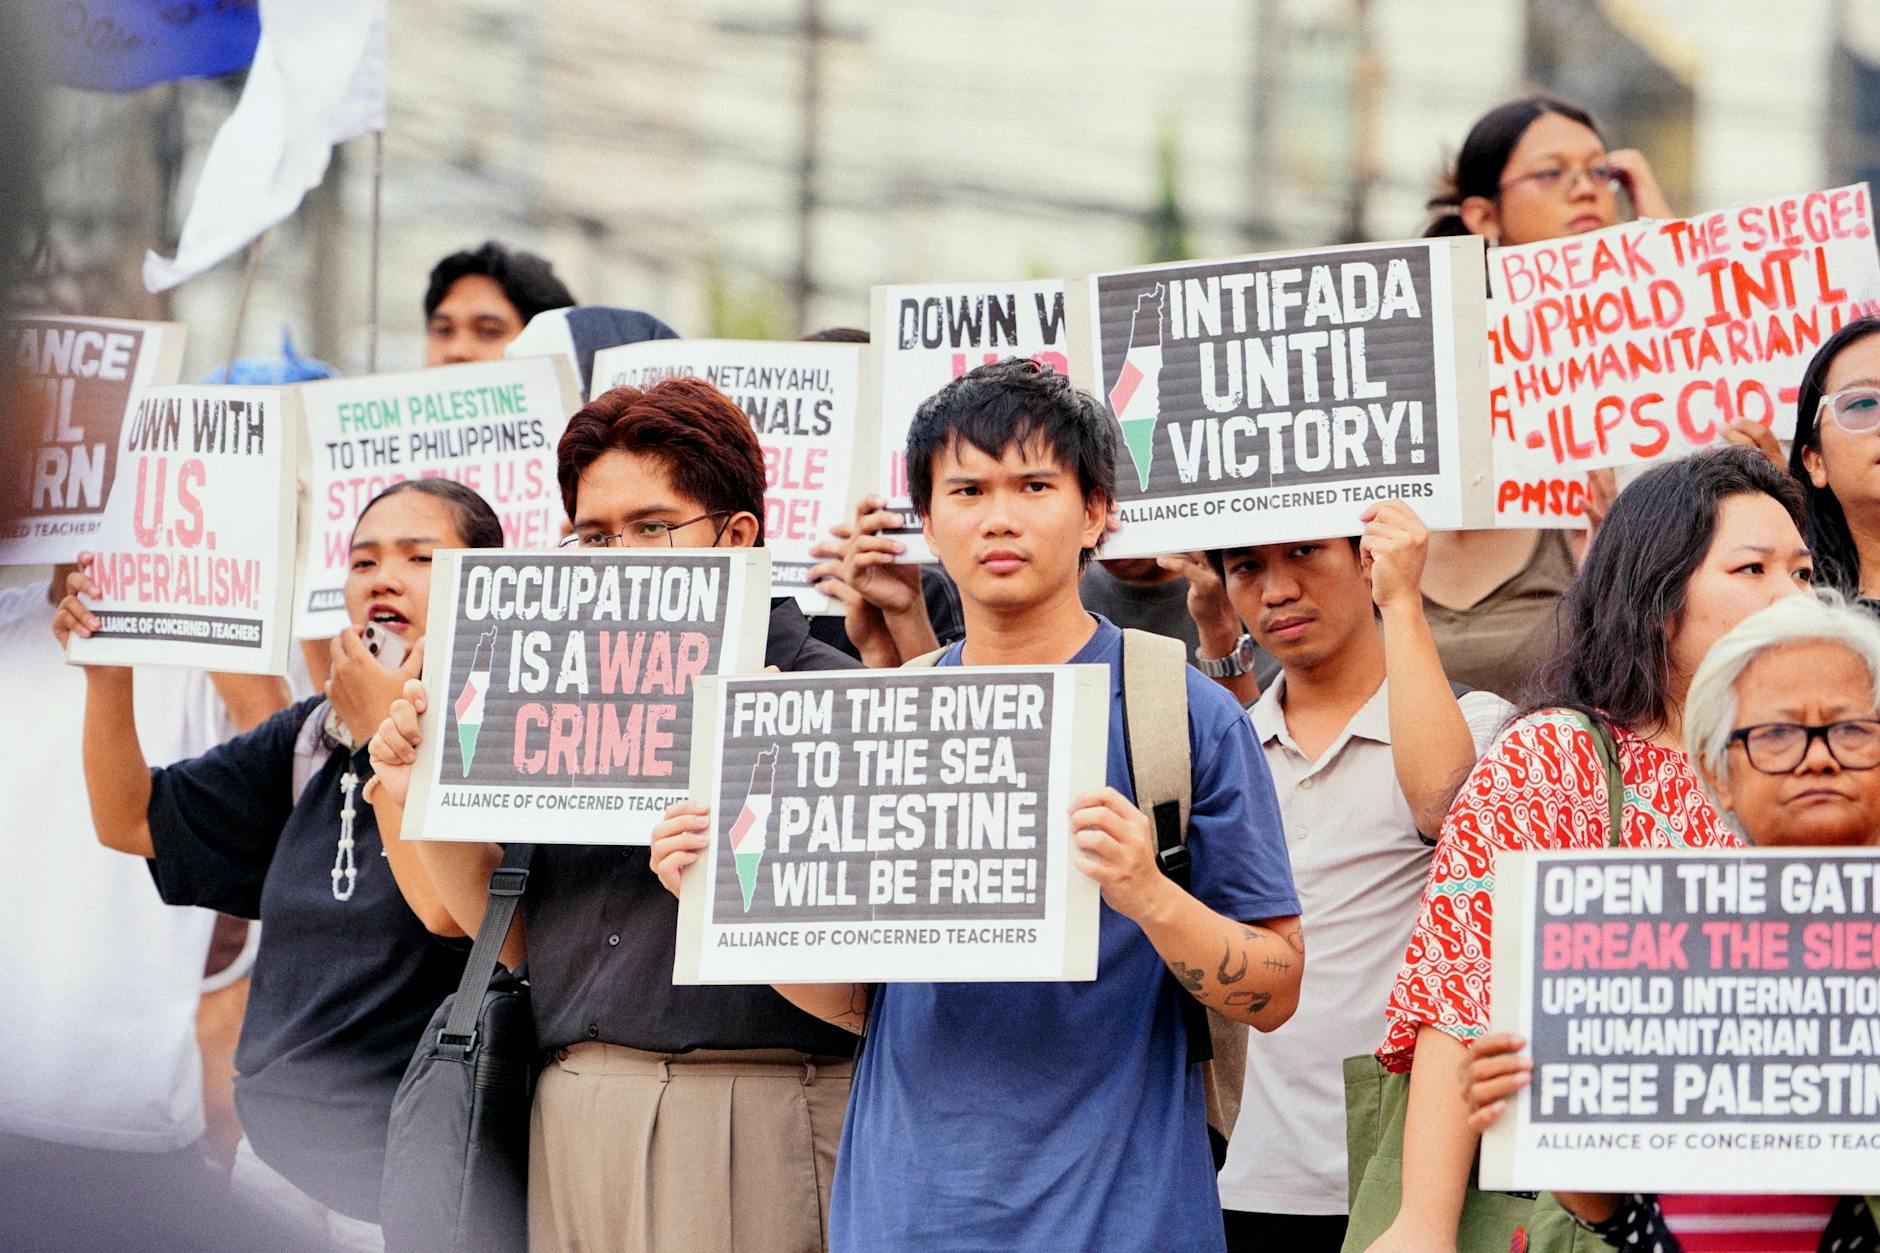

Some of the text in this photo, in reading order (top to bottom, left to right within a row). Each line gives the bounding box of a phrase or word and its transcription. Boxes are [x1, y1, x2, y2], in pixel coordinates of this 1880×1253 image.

[1502, 190, 1871, 304] BREAK THE SIEGE!
[898, 294, 1018, 351] DOWN
[1169, 258, 1421, 340] INTIFADA
[1503, 279, 1684, 362] UPHOLD
[1697, 246, 1847, 328] INT'L
[705, 365, 834, 395] NETANYAHU,
[1199, 327, 1388, 414] UNTIL
[1514, 305, 1820, 407] HUMANITARIAN
[193, 399, 264, 456] WITH
[337, 384, 528, 434] FROM PALESTINE
[326, 420, 552, 471] TO THE PHILIPPINES,
[1167, 400, 1425, 484] VICTORY!
[134, 456, 216, 550] U.S.
[495, 458, 551, 504] U.S.
[1120, 482, 1434, 523] ALLIANCE OF CONCERNED TEACHERS
[465, 565, 720, 623] OCCUPATION
[138, 617, 153, 634] OF
[211, 620, 260, 642] TEACHERS
[507, 630, 710, 696] IS A WAR
[733, 684, 1045, 738] FROM THE RIVER
[513, 702, 677, 777] CRIME
[792, 736, 1027, 788] TO THE SEA,
[441, 792, 688, 812] ALLIANCE OF CONCERNED TEACH
[778, 792, 1037, 853] PALESTINE
[772, 858, 1036, 907] WILL BE FREE!
[1543, 864, 1663, 916] OPEN
[1677, 863, 1767, 914] THE
[717, 928, 1037, 948] ALLIANCE OF CONCERNED TEACHERS
[1542, 921, 1689, 971] BREAK
[1702, 921, 1790, 970] THE
[1542, 976, 1880, 1015] UPHOLD INTERNATIO
[1567, 1018, 1819, 1057] HUMANITARIAN
[1540, 1063, 1658, 1116] FREE
[1537, 1133, 1641, 1150] ALLIANCE
[1649, 1133, 1679, 1150] OF
[1685, 1133, 1822, 1150] CONCERNED
